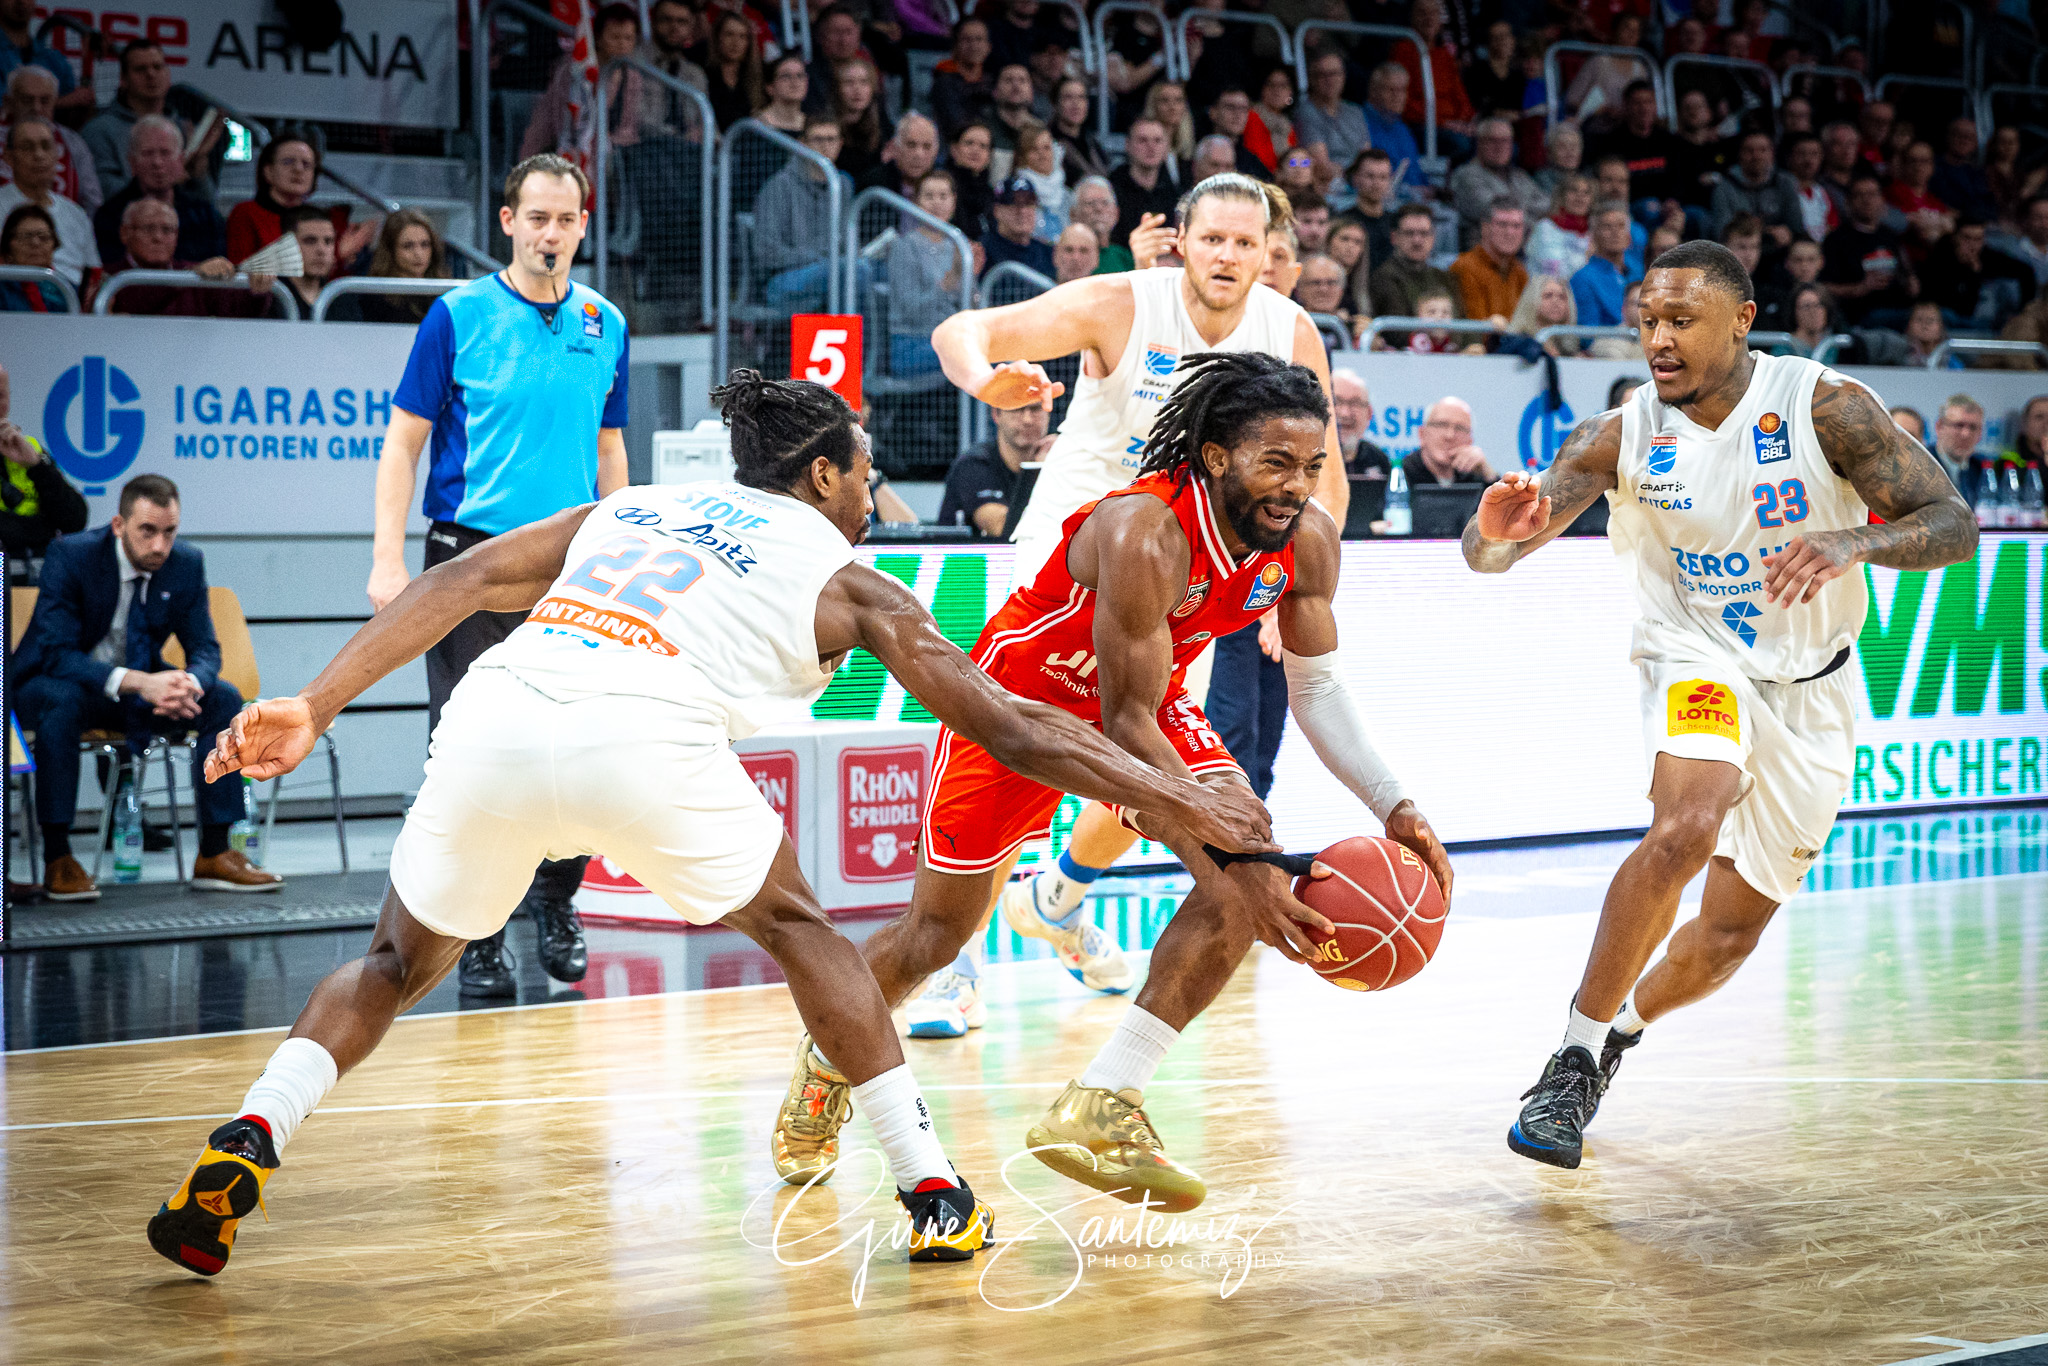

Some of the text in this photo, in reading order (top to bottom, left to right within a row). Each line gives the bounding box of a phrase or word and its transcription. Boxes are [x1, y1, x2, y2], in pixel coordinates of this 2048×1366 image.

[805, 329, 848, 388] 5
[173, 434, 318, 460] MOTOREN
[1760, 446, 1787, 461] BBL
[1640, 483, 1675, 492] CRAFT
[1752, 477, 1810, 529] 23
[1669, 546, 1750, 577] ZERO
[561, 535, 704, 622] 22
[1698, 580, 1763, 596] MOTORR
[1248, 597, 1273, 607] BBL
[1039, 665, 1090, 698] Technik
[1677, 708, 1735, 726] LOTTO
[850, 764, 919, 803] RHÖN
[1840, 737, 2041, 803] RSICHER
[849, 804, 920, 829] SPRUDEL
